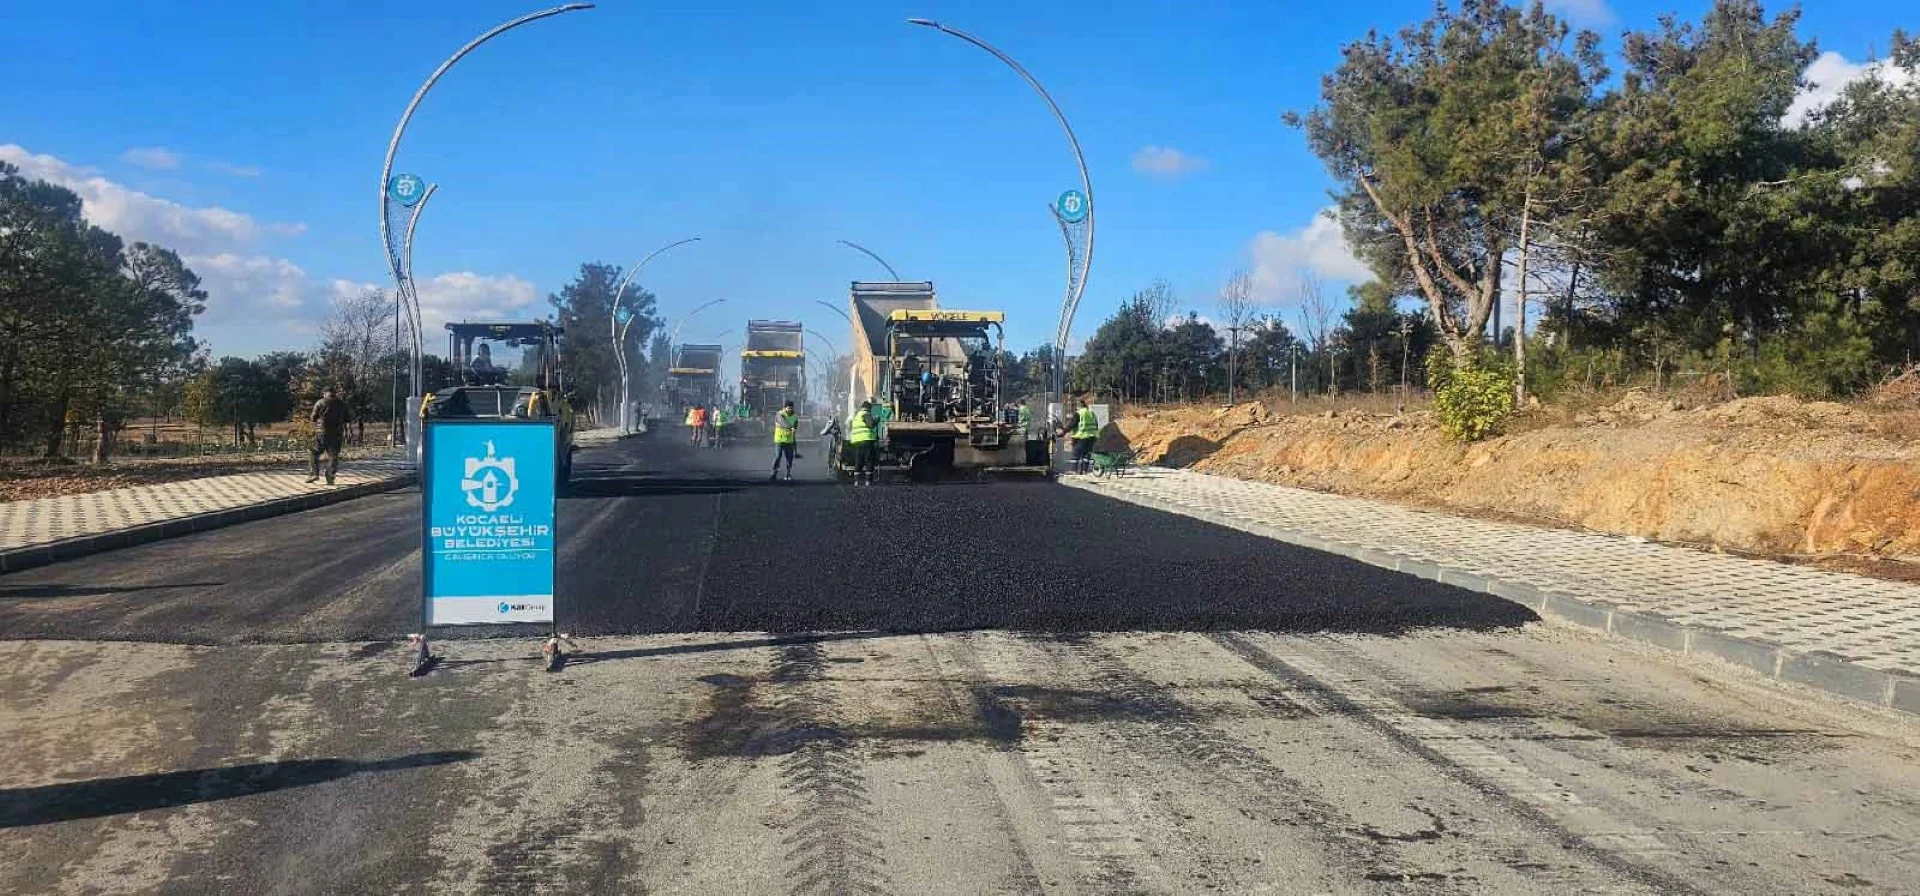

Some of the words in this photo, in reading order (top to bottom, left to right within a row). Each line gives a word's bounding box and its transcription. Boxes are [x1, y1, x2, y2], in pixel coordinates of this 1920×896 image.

[456, 514, 523, 525] KOCAELİ
[431, 525, 549, 537] BÜYÜKŞEHİR
[444, 537, 535, 549] BELEDİYESİ
